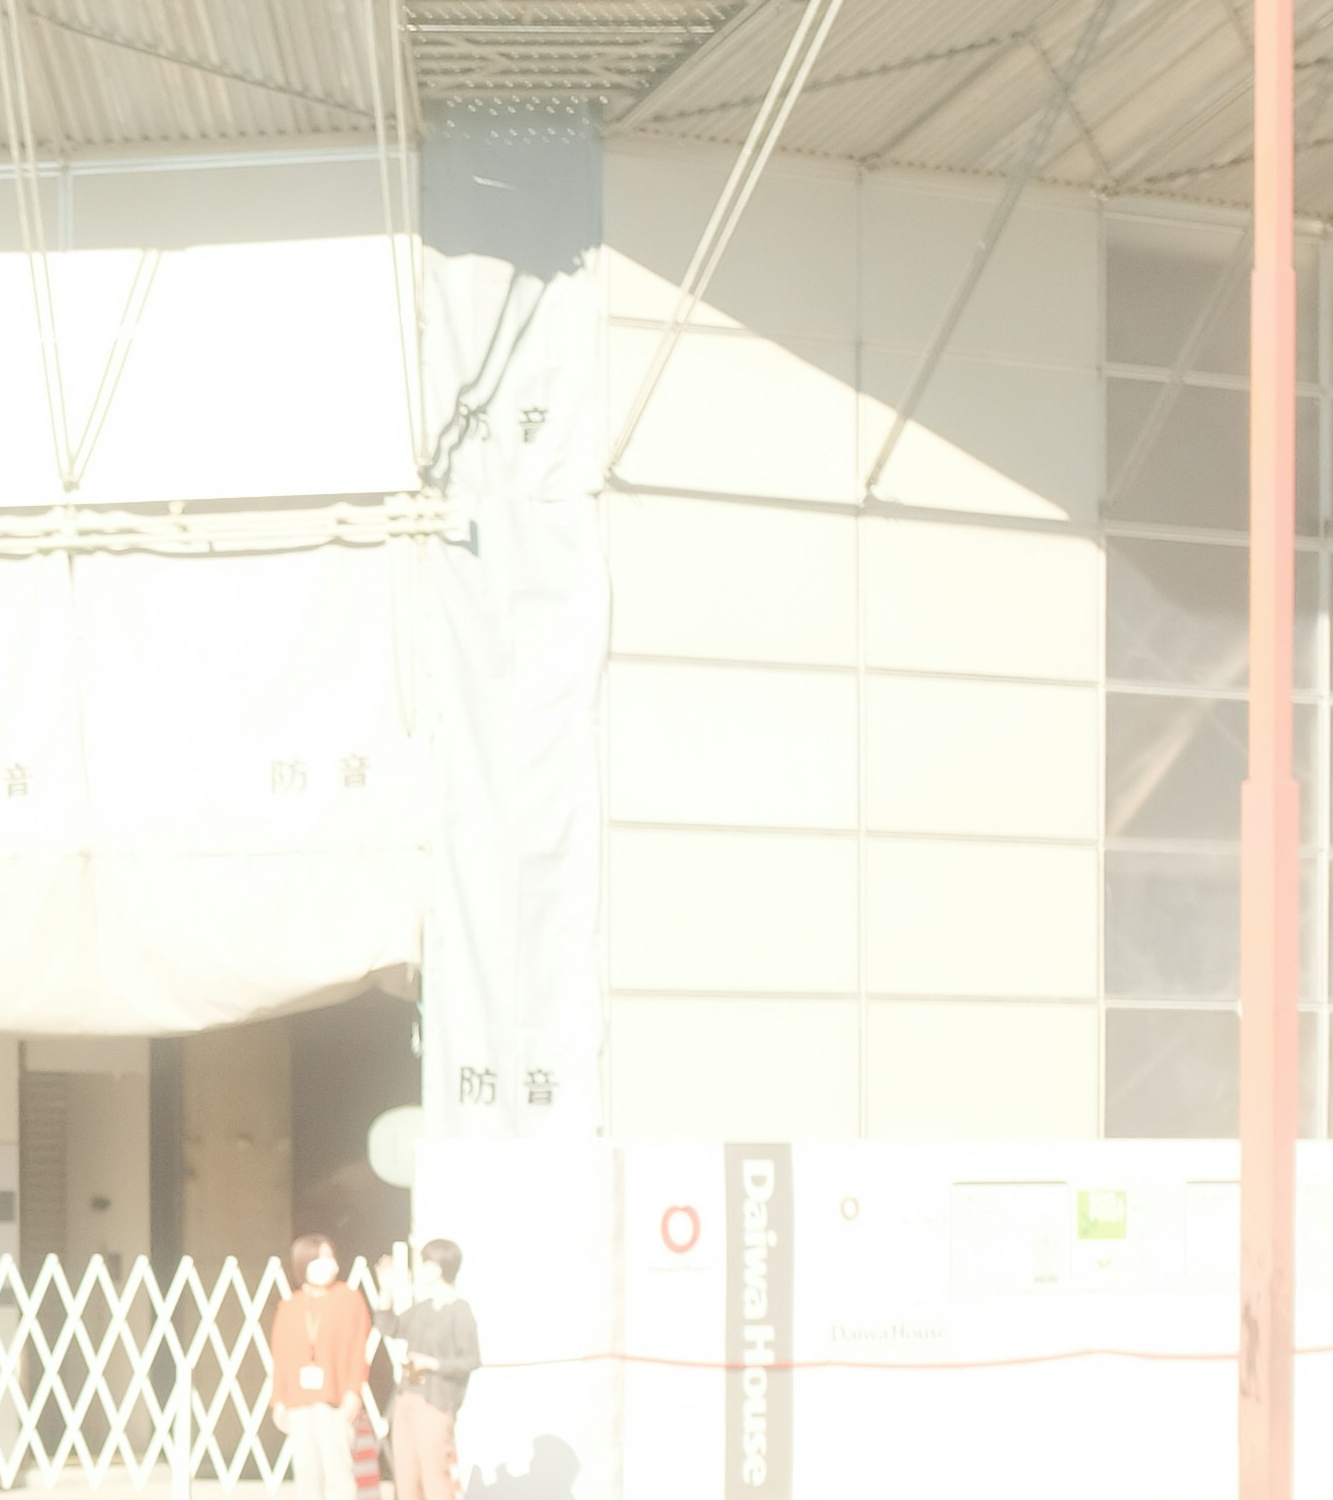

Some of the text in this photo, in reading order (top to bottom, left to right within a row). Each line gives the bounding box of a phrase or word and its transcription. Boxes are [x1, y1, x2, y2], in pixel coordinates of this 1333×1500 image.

[269, 753, 373, 794] 防音
[459, 1065, 561, 1105] 防音
[742, 1159, 779, 1487] Daiwa House
